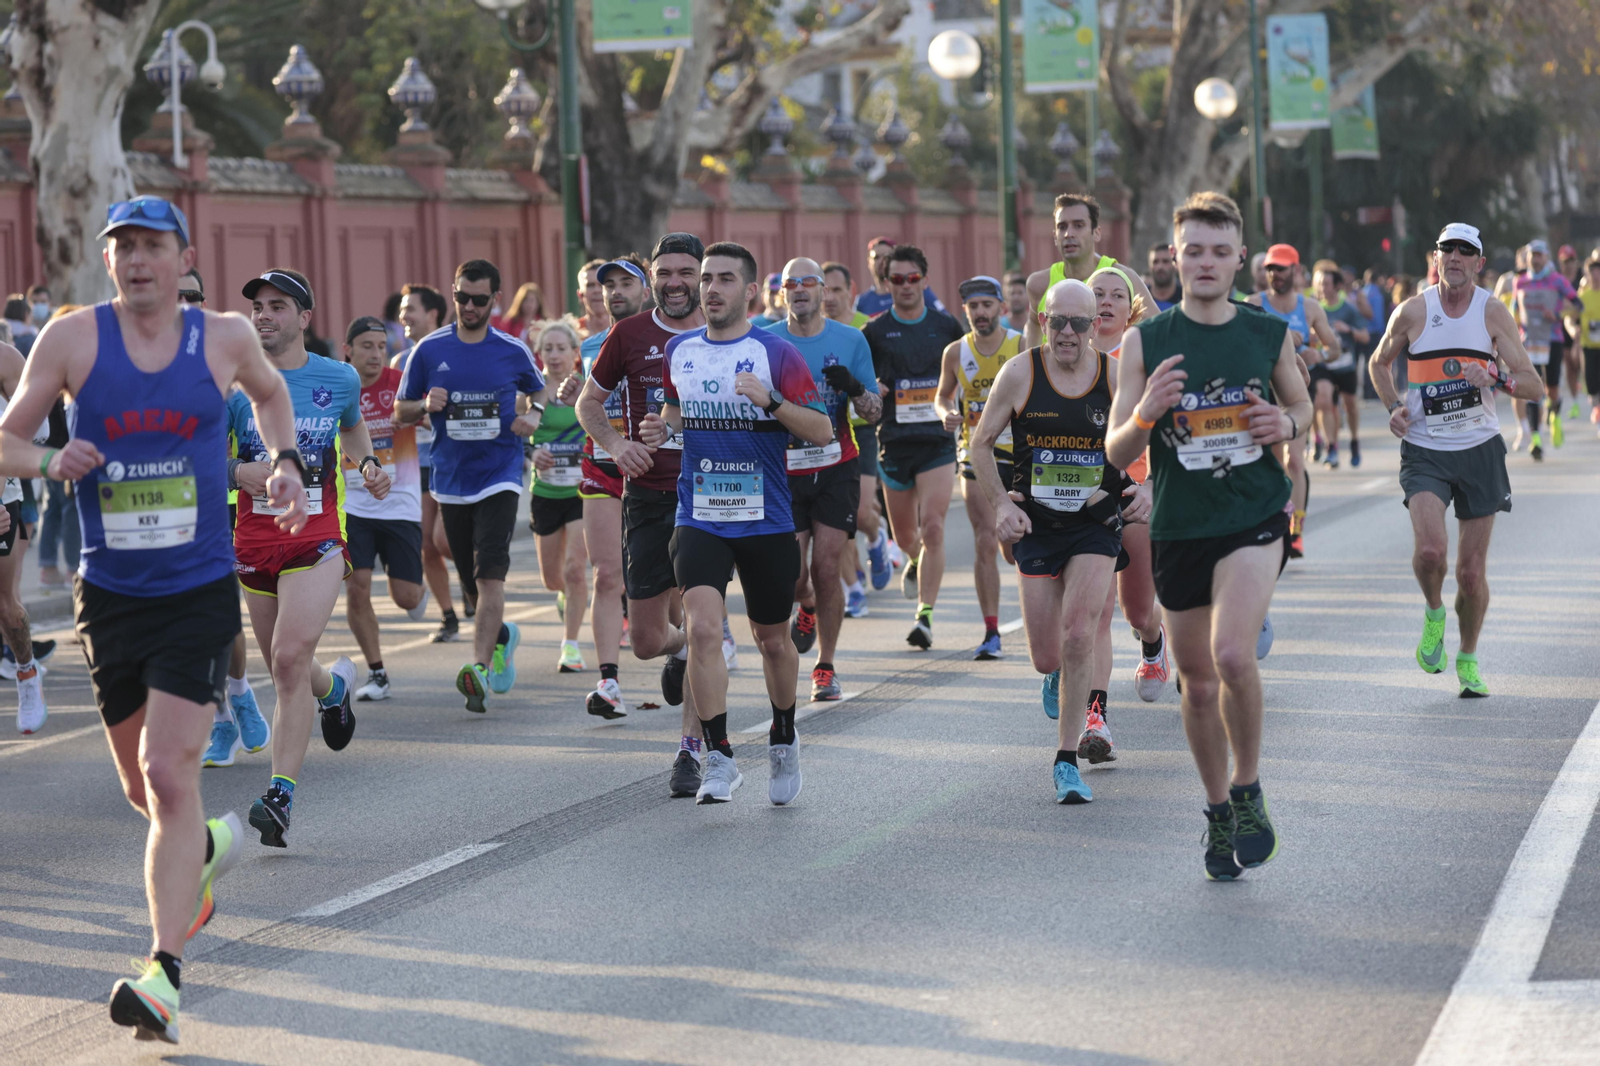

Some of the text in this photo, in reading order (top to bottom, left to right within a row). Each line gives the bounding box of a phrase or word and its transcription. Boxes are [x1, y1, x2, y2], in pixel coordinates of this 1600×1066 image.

[702, 380, 720, 394] 10
[463, 393, 495, 401] ZURICH
[682, 400, 759, 420] NFORMALES
[1442, 398, 1463, 411] 3157
[464, 408, 484, 418] 1796
[606, 409, 623, 417] ZURI
[1442, 411, 1468, 423] CATHAL
[103, 408, 200, 441] ARENA
[459, 421, 487, 429] YOUNESS
[1204, 416, 1233, 431] 4989
[1026, 434, 1093, 448] BLACKROCK
[1202, 436, 1238, 449] 300896
[552, 443, 580, 451] ZURICH
[803, 447, 825, 457] TRUCA
[1056, 453, 1095, 464] ZURICH
[127, 460, 184, 478] ZURICH
[714, 462, 754, 471] ZURICH
[1056, 473, 1080, 483] 1323
[712, 482, 742, 492] 11700
[131, 490, 164, 507] 1138
[1054, 489, 1081, 497] BARRY
[708, 498, 746, 507] MONCAYO
[138, 514, 160, 527] KEV
